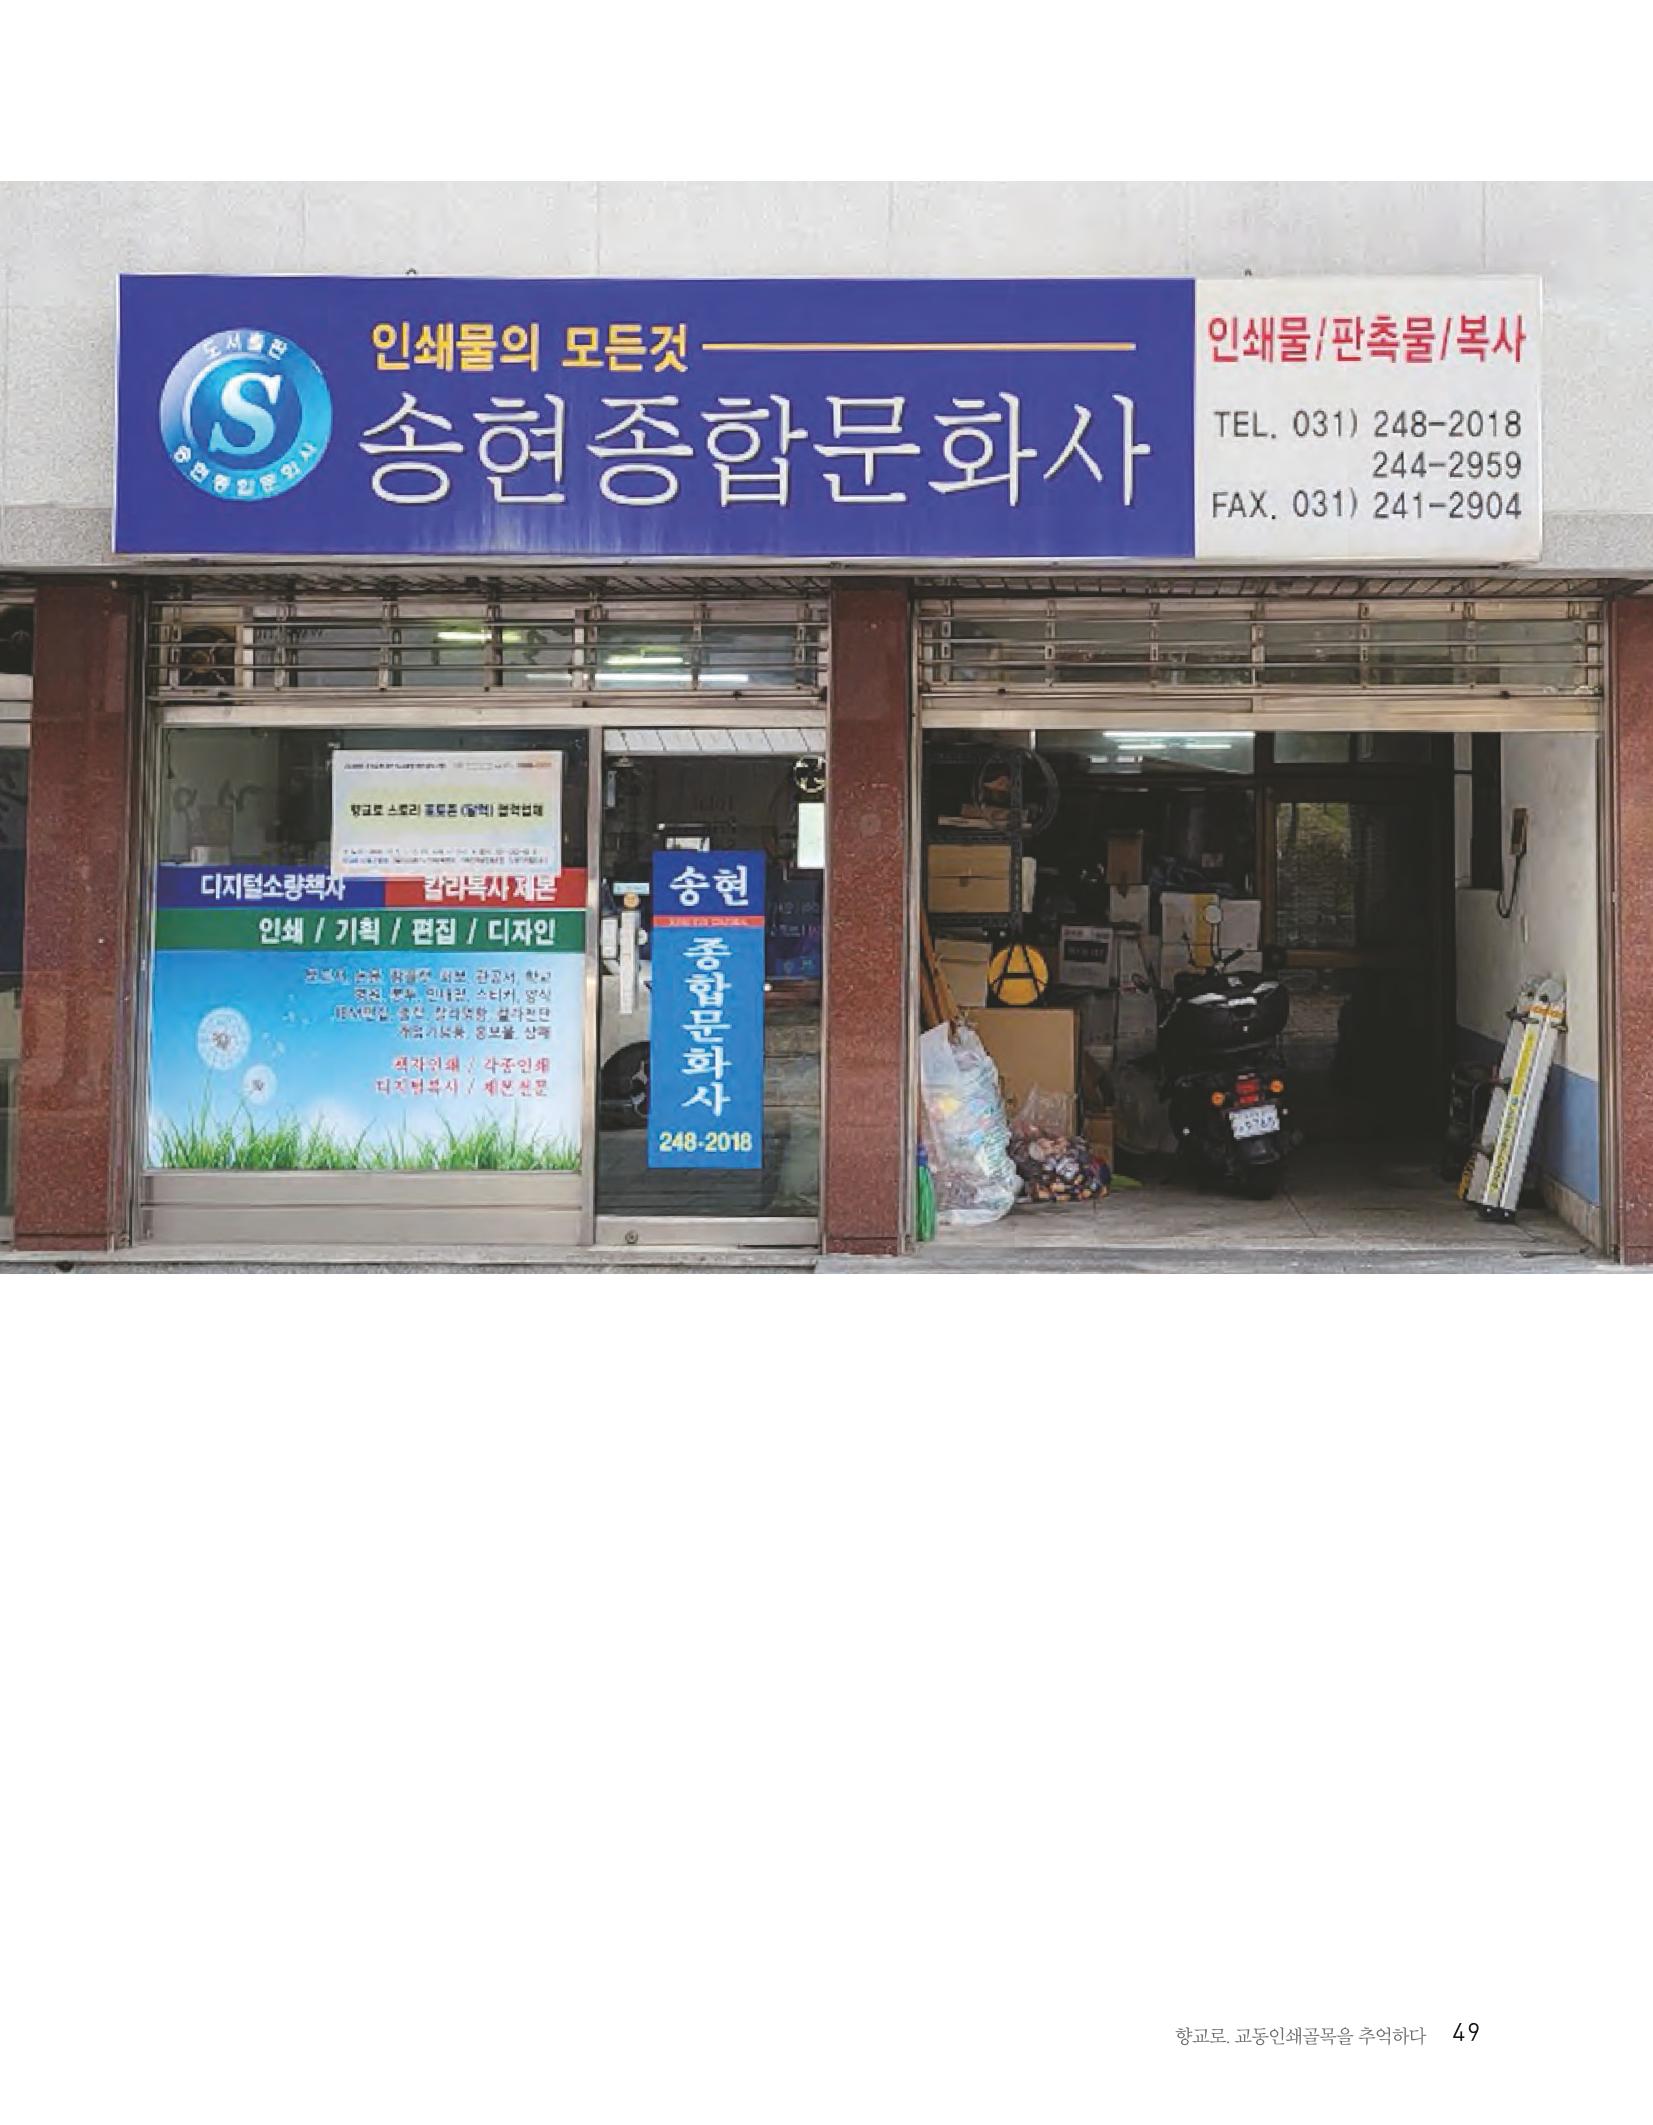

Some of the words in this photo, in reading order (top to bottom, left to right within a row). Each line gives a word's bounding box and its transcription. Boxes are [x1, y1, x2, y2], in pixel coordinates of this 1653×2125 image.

[371, 322, 541, 372] 인쇄물의
[562, 322, 690, 373] 모든것
[1208, 314, 1527, 363] 인쇄물/판촉물/복사
[208, 372, 283, 455] S
[1214, 410, 1277, 439] TEL.
[1293, 409, 1358, 439] 031)
[1373, 409, 1522, 438] 248-2018
[358, 391, 1152, 507] 송현종합문화사
[1372, 450, 1522, 479] 244-2959
[1212, 491, 1277, 520] FAX.
[1292, 489, 1358, 519] 031)
[1373, 491, 1523, 520] 241-2904
[200, 872, 346, 901] 디지털소량책자
[669, 865, 749, 907] 송현
[258, 917, 304, 945] 인쇄
[335, 917, 380, 945] 기획
[411, 917, 456, 946] 편집
[488, 917, 555, 946] 디자인
[682, 937, 733, 1117] 종합문화사
[659, 1131, 753, 1153] 248-2018
